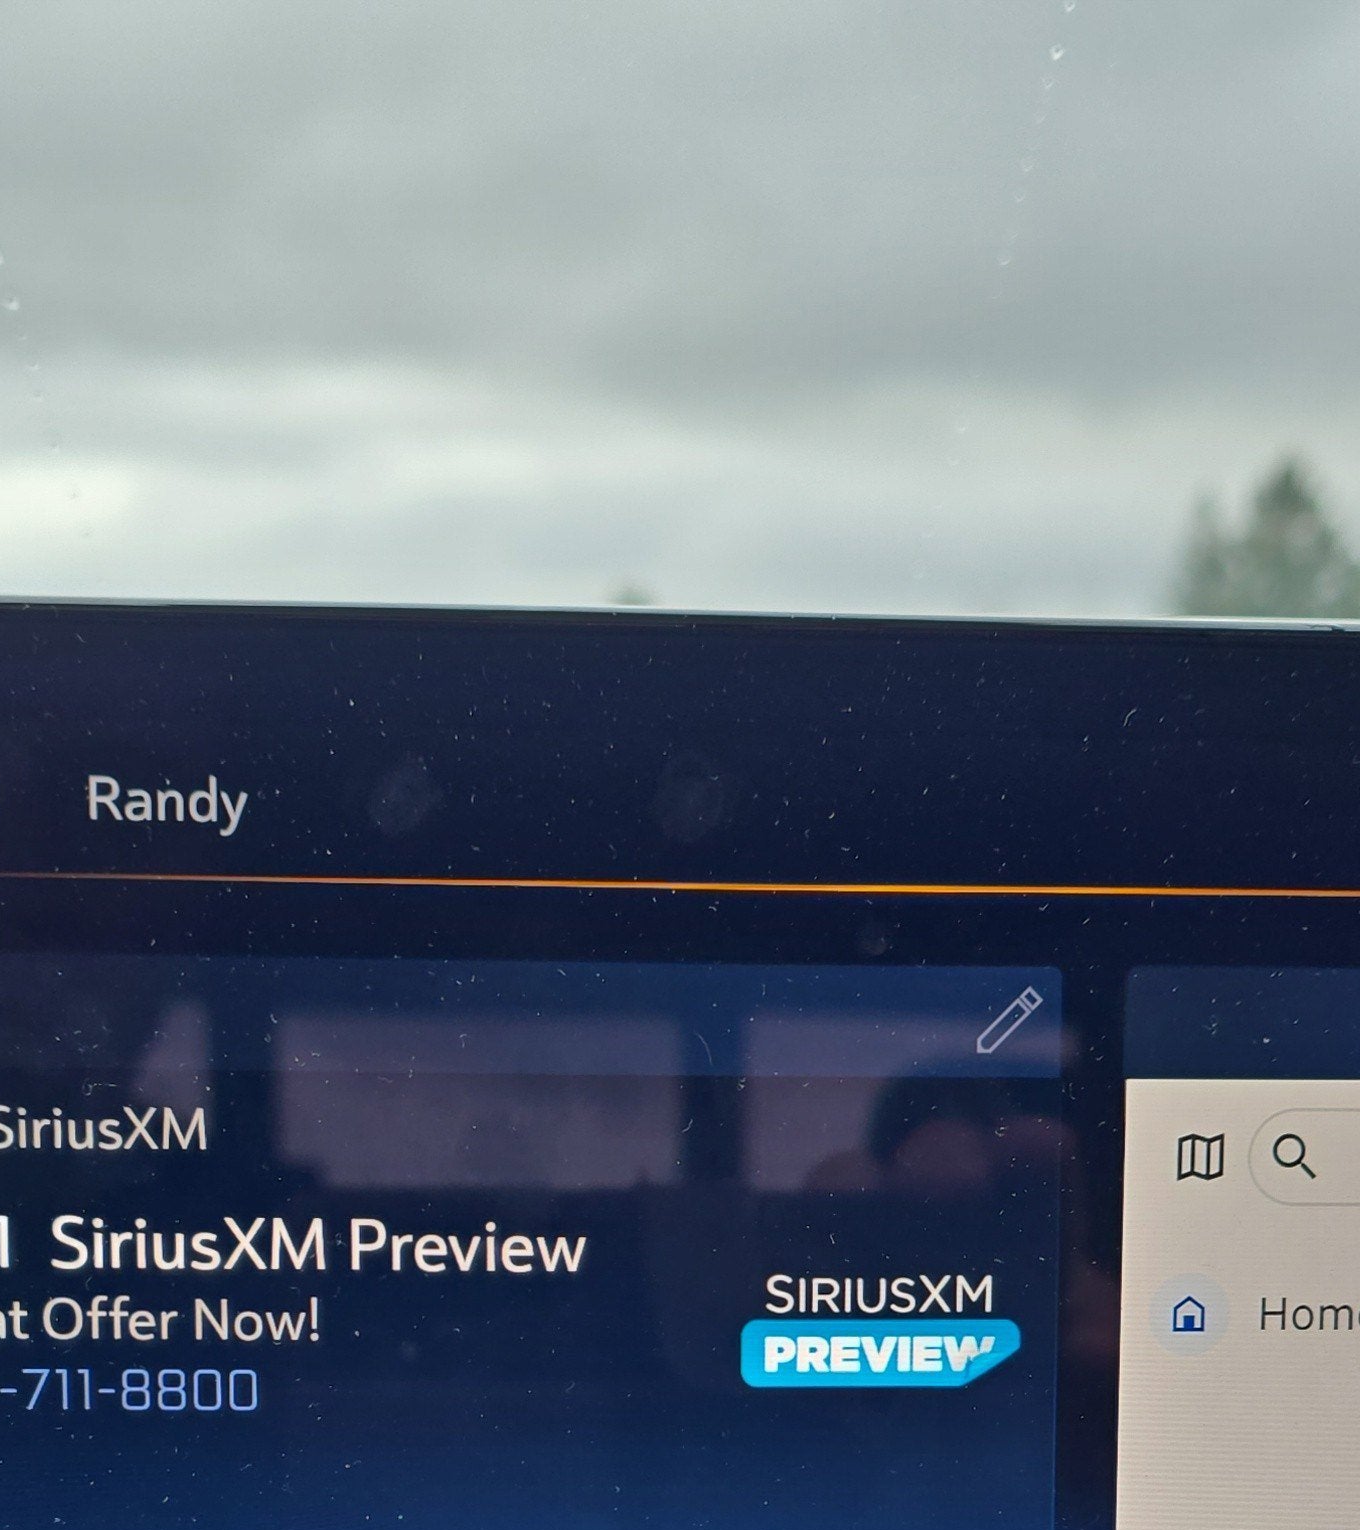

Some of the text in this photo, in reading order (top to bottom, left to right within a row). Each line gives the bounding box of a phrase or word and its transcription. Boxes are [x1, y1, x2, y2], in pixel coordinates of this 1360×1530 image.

[86, 775, 248, 837] Randy
[50, 1215, 327, 1271] SiriusXM
[350, 1217, 587, 1273] Preview
[765, 1274, 993, 1313] SIRIUSXM
[42, 1296, 179, 1341] Offer
[194, 1299, 320, 1342] Now!
[764, 1336, 996, 1373] PREVIEW
